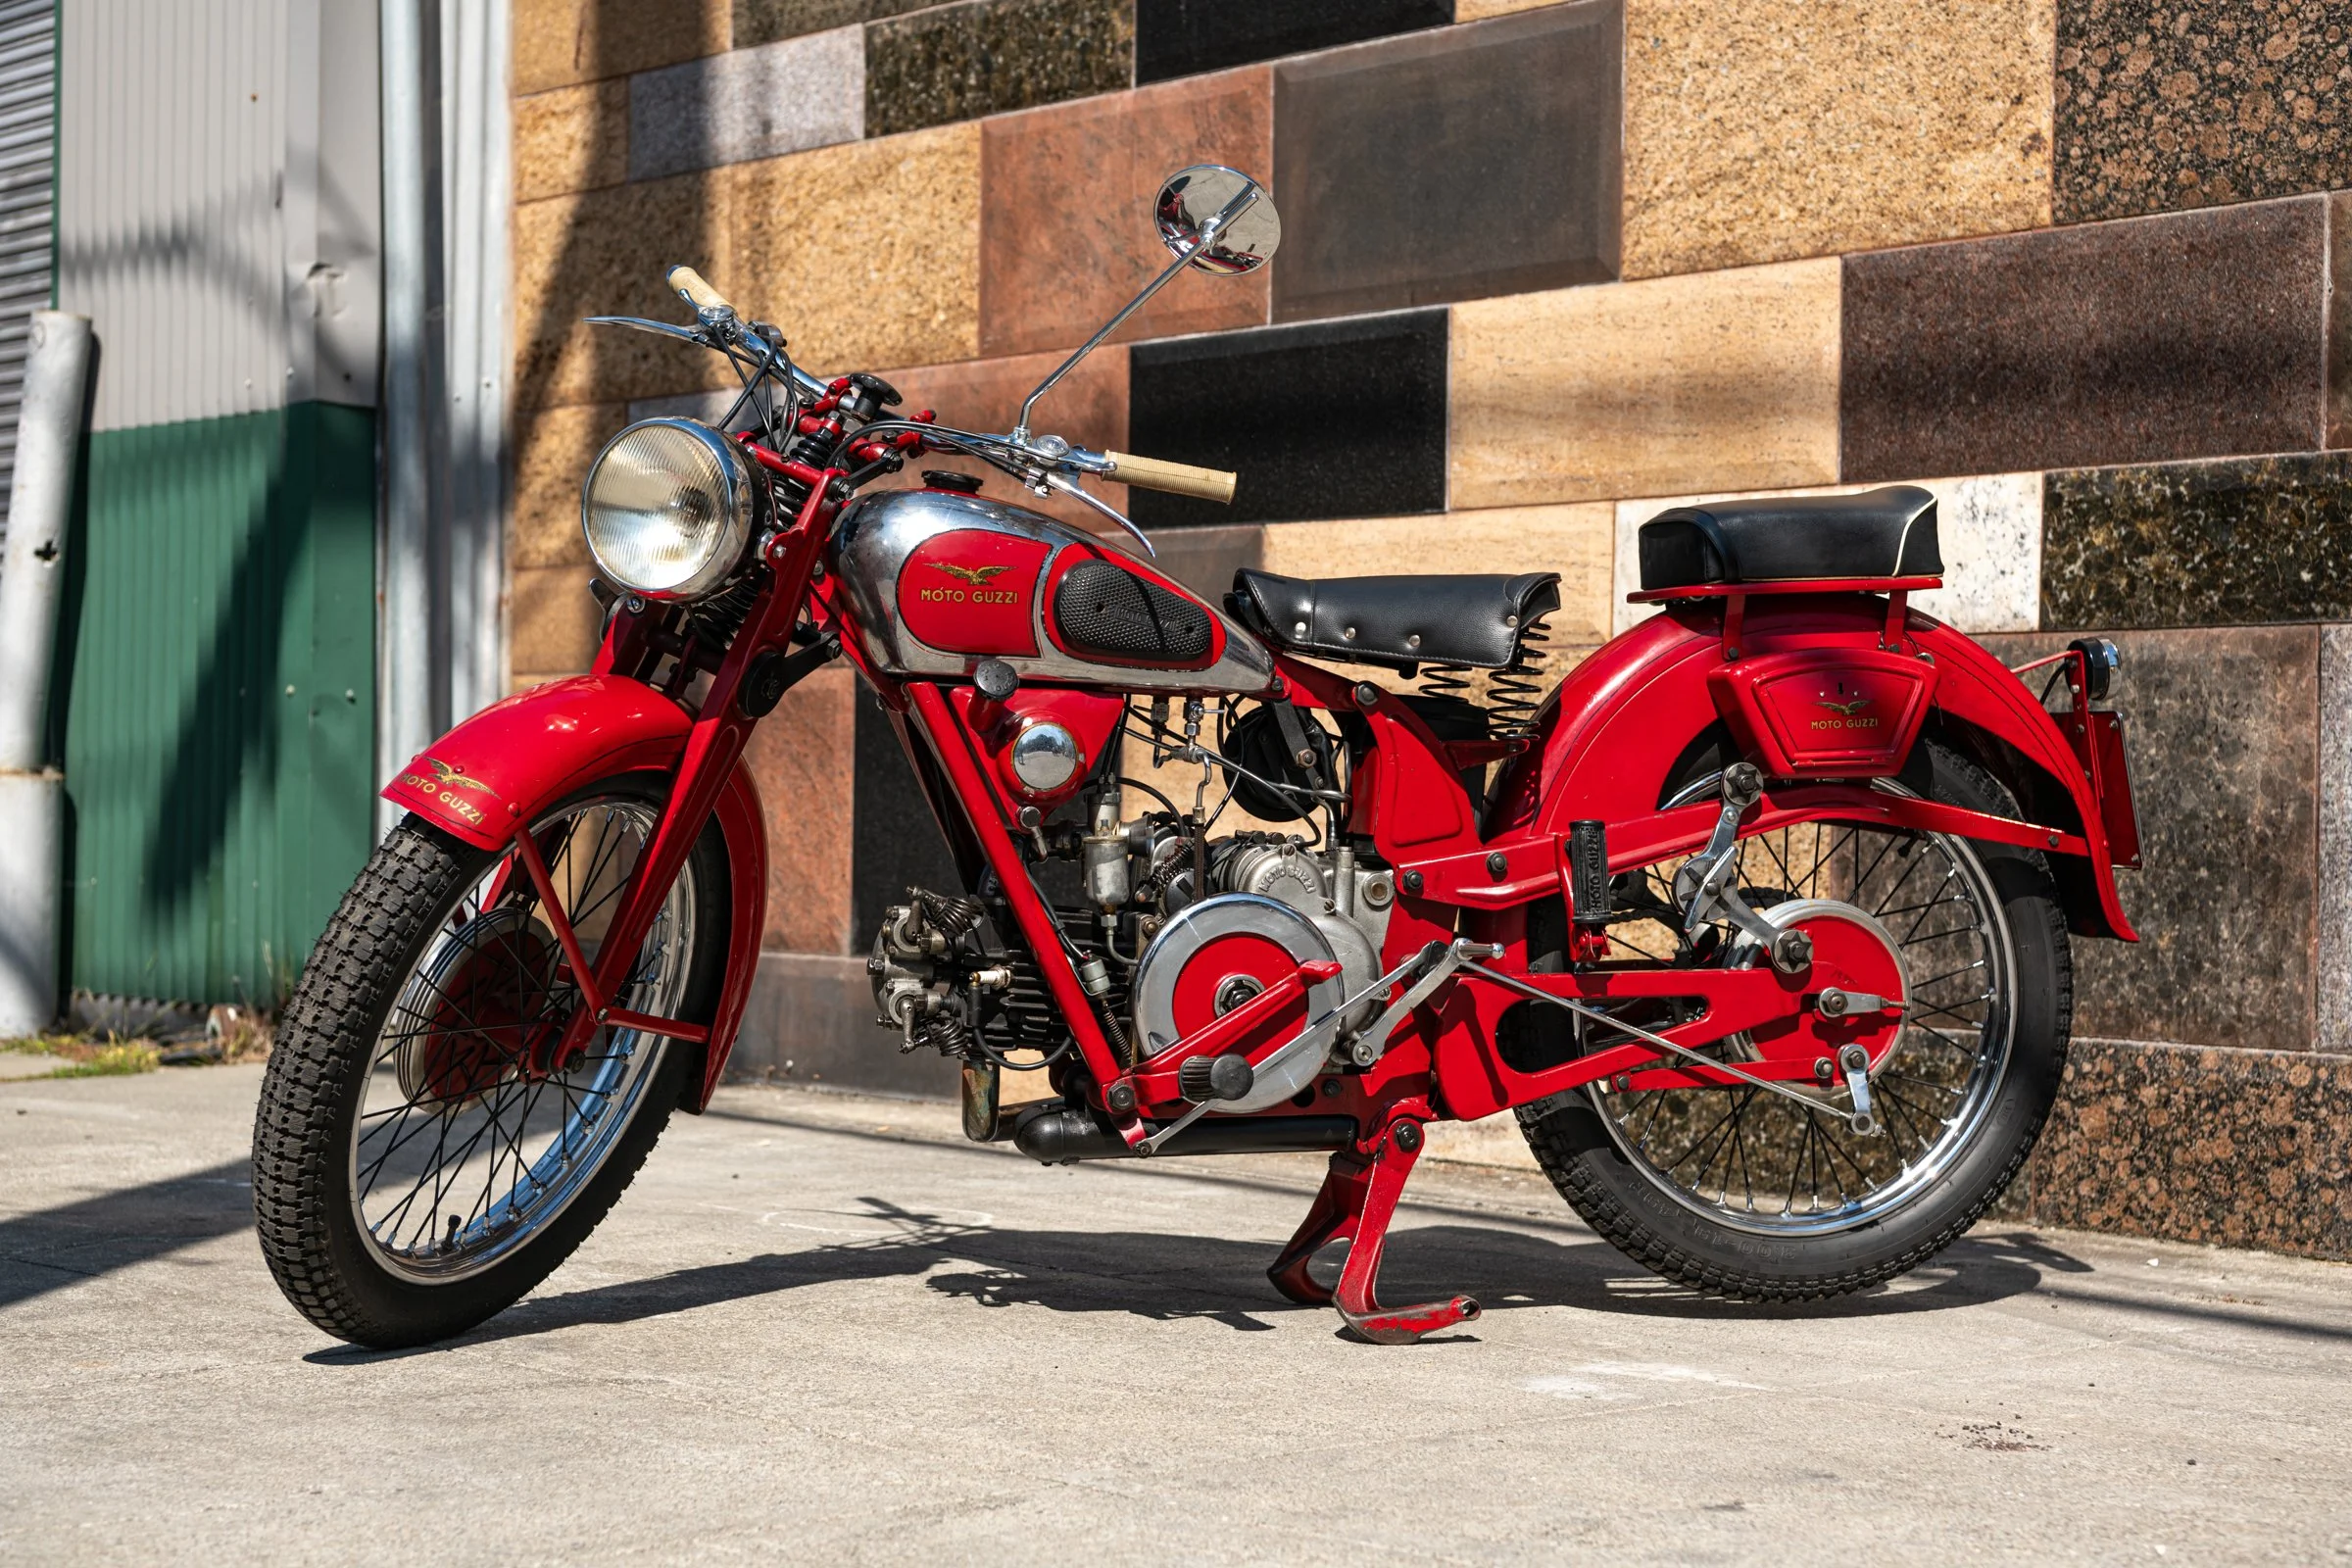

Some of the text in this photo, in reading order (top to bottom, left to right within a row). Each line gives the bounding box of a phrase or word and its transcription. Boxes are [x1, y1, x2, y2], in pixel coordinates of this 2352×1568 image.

[920, 588, 1018, 604] MOTO GUZZI
[1811, 717, 1879, 730] MOTO GUZZI
[400, 773, 483, 825] MOTO GUZZI
[1258, 864, 1316, 894] MOTO GUZZI
[1590, 875, 1602, 909] MOTO
